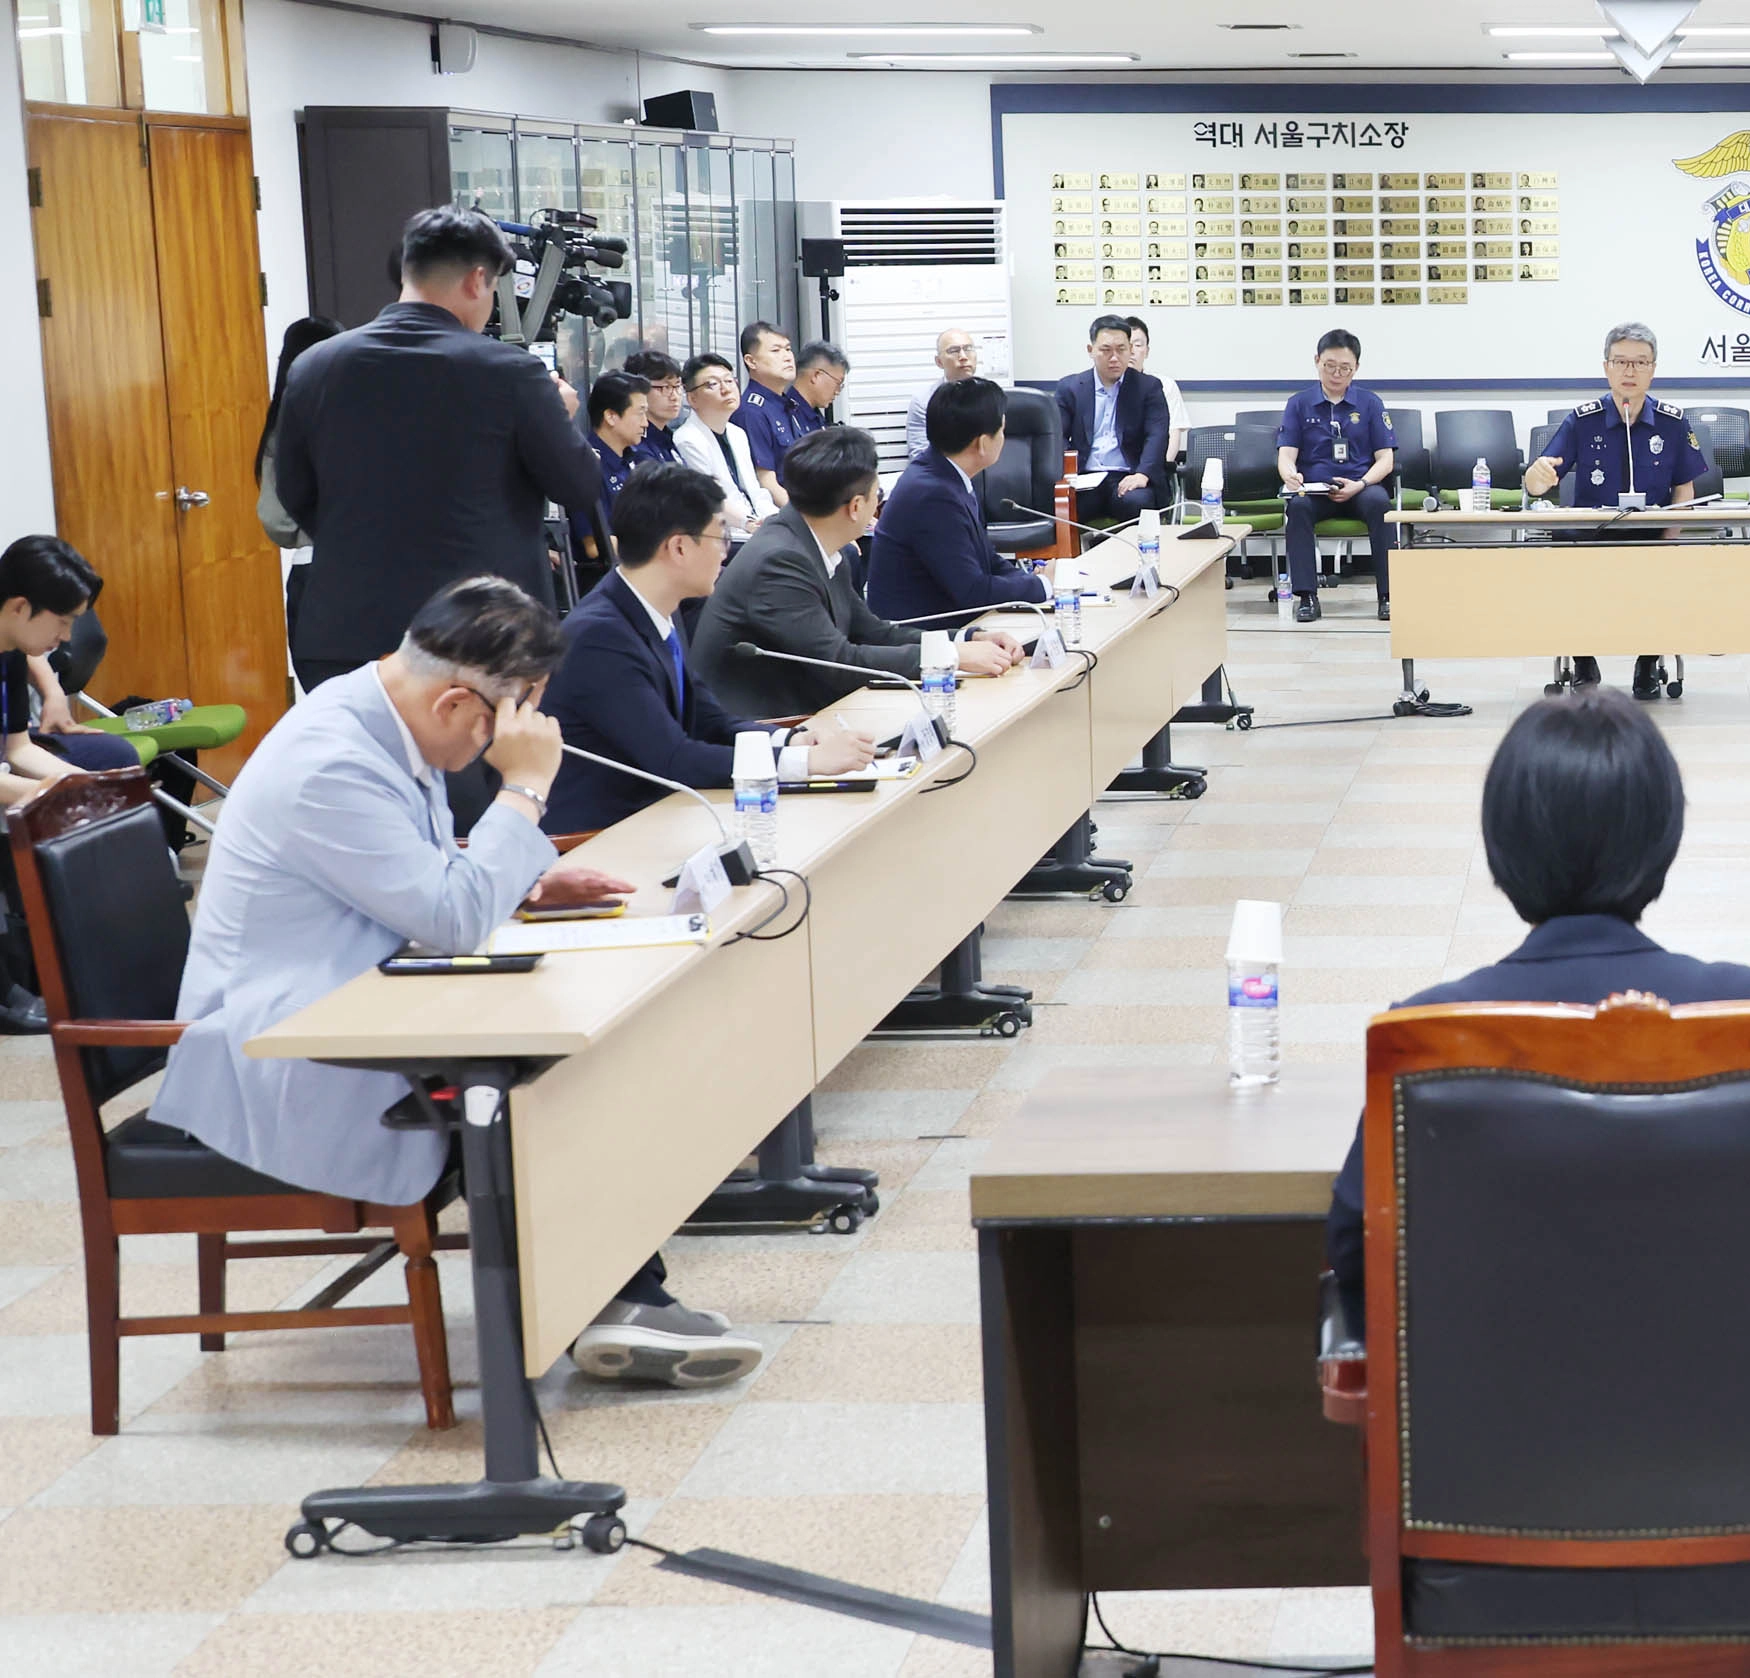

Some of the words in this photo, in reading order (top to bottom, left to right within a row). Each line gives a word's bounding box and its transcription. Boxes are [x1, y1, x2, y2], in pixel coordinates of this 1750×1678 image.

[1193, 122, 1243, 148] 역대
[1254, 120, 1410, 149] 서울구치소장
[1699, 251, 1719, 291] KOREA
